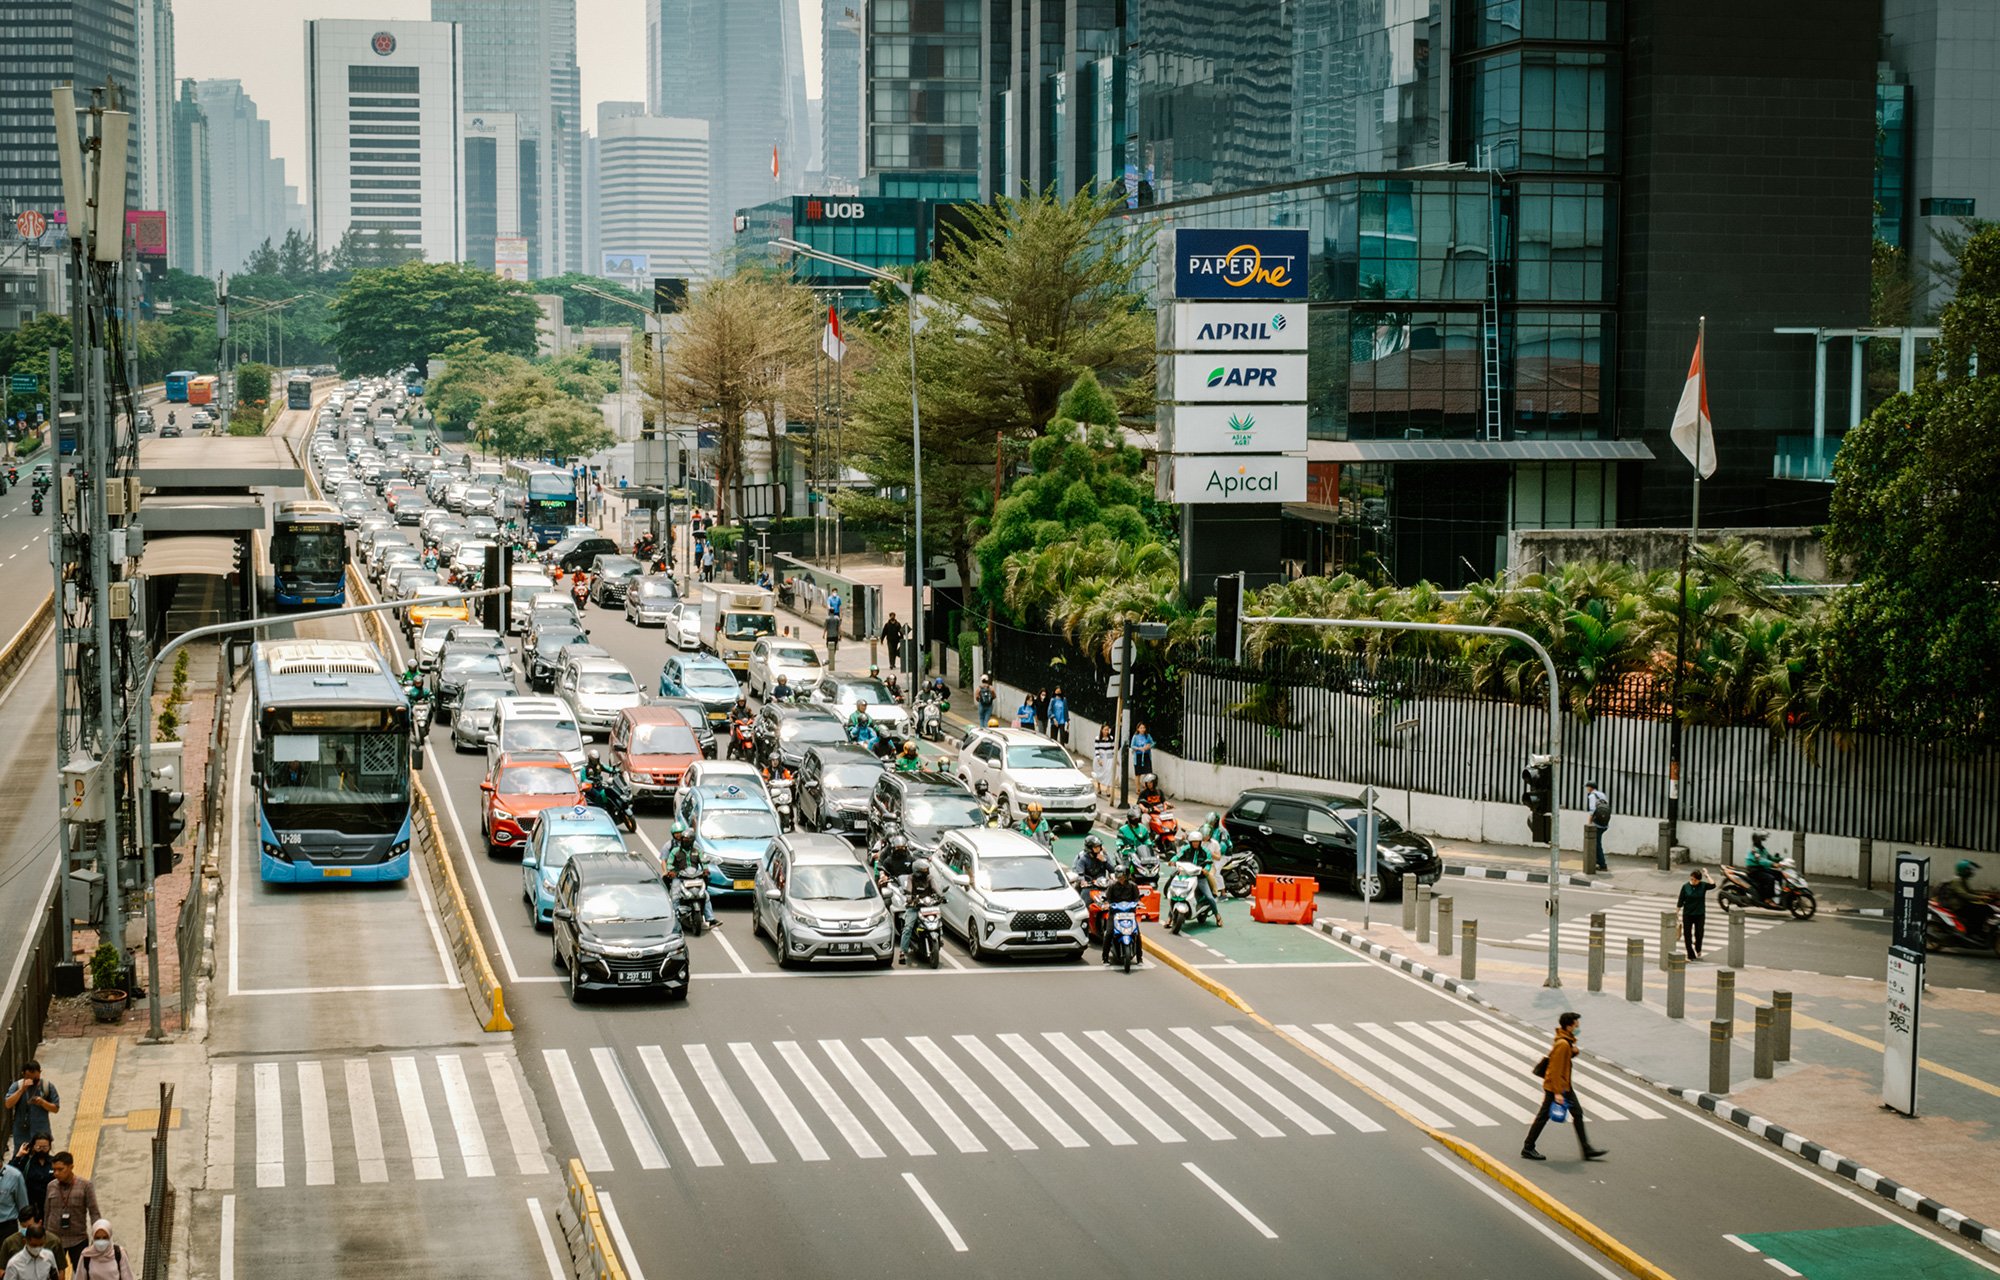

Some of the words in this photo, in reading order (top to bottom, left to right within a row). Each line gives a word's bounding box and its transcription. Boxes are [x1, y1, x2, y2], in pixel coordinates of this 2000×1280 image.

[825, 203, 865, 219] UOB
[1189, 258, 1255, 275] PAPER
[1196, 323, 1272, 340] APRIL
[1224, 368, 1278, 387] APR
[1205, 467, 1278, 498] Apical
